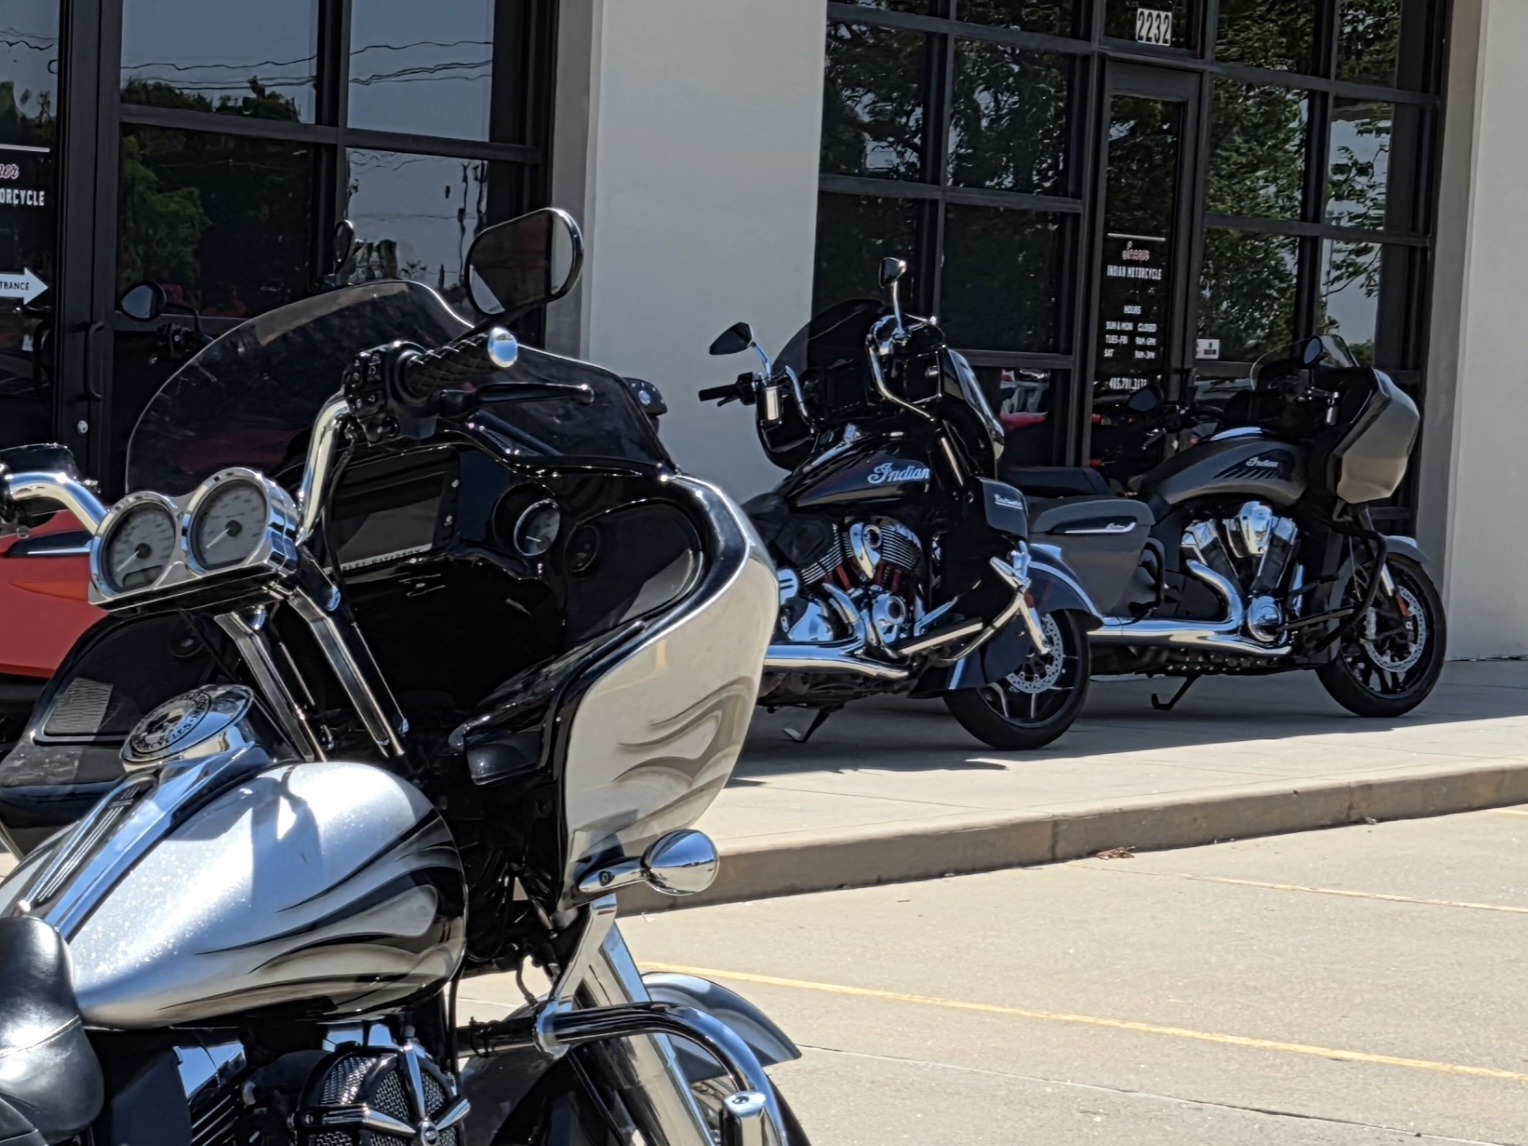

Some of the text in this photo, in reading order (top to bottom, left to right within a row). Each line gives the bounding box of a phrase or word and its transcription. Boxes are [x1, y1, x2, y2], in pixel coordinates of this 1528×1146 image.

[1137, 10, 1170, 44] 2232
[1127, 266, 1162, 280] MOTORCYCLE
[867, 462, 930, 484] Indian
